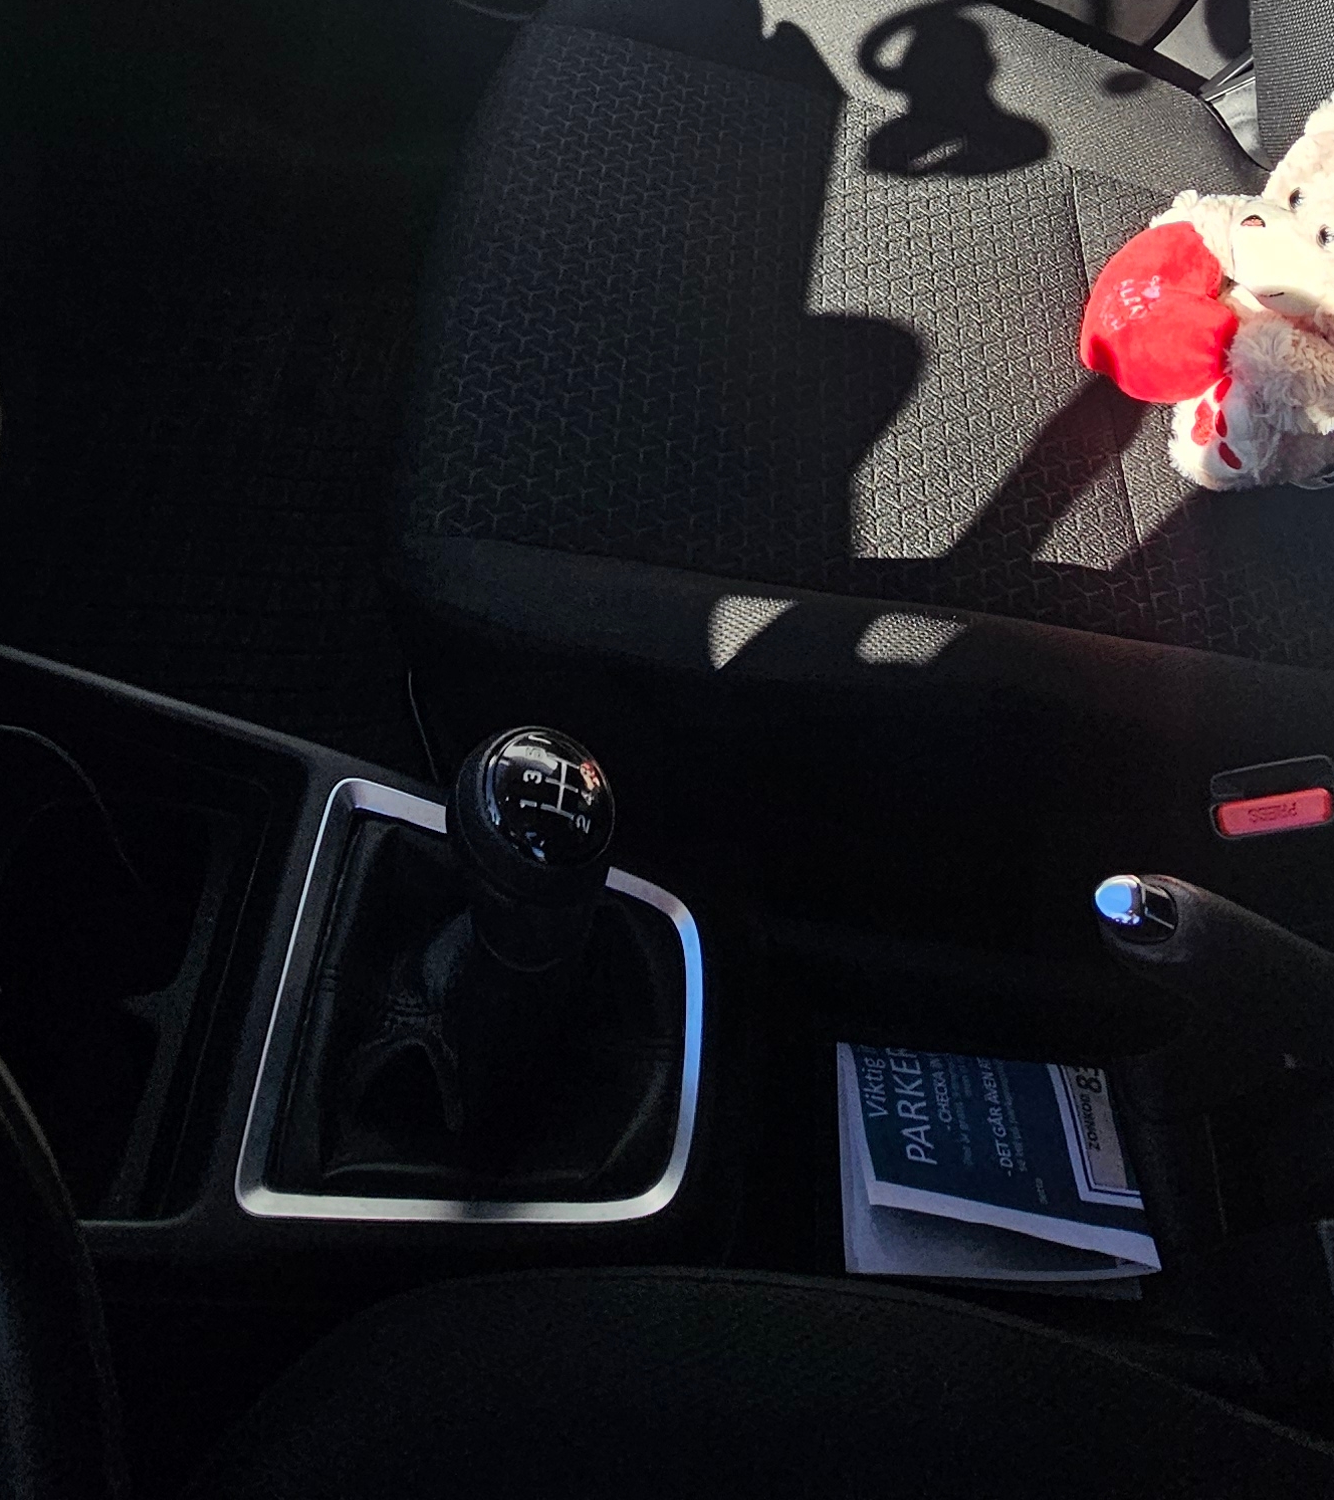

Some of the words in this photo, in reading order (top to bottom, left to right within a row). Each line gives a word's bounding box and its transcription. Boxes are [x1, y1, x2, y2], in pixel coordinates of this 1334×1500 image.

[522, 769, 543, 785] 3
[575, 814, 592, 834] 2
[862, 1055, 890, 1118] Viktig
